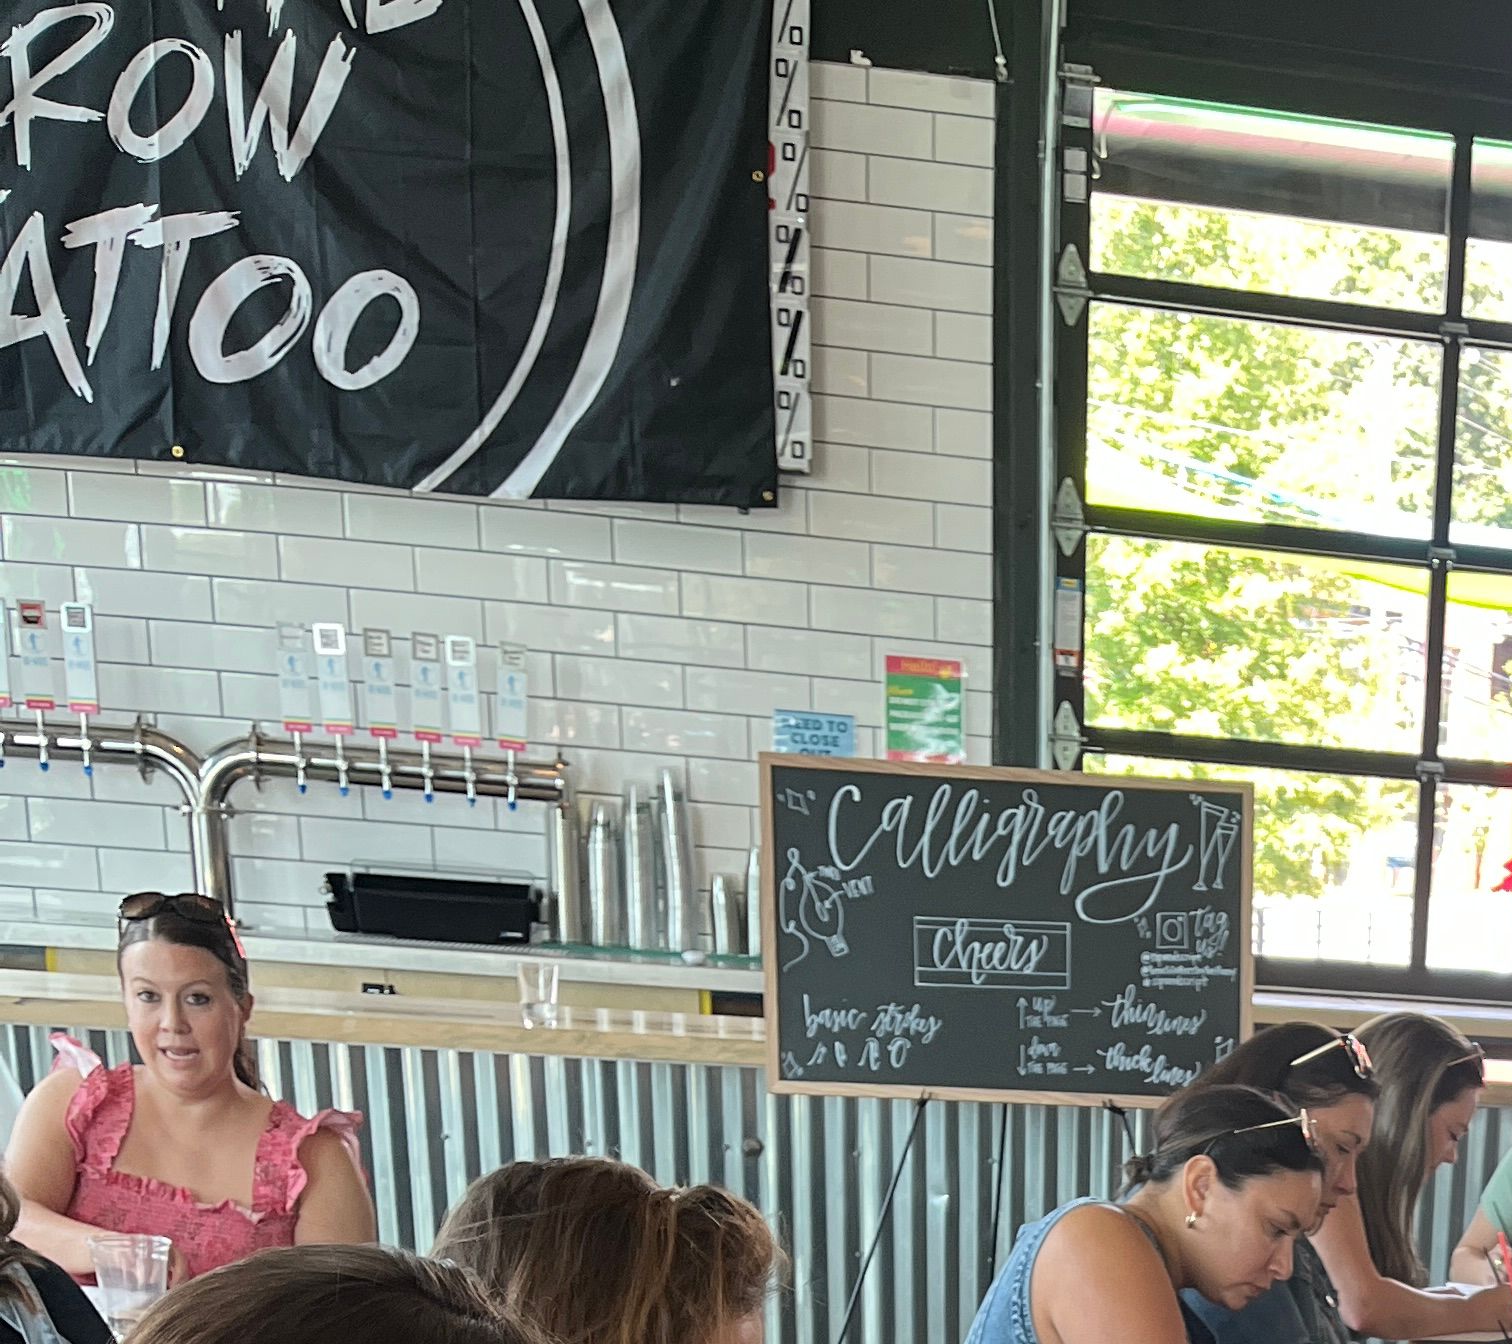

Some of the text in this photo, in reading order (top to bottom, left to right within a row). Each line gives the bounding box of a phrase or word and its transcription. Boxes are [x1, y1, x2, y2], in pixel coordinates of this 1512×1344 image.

[0, 200, 420, 403] ATTOO
[790, 732, 840, 748] CLOSE
[826, 719, 848, 733] TO
[828, 783, 1194, 924] Calligraphy
